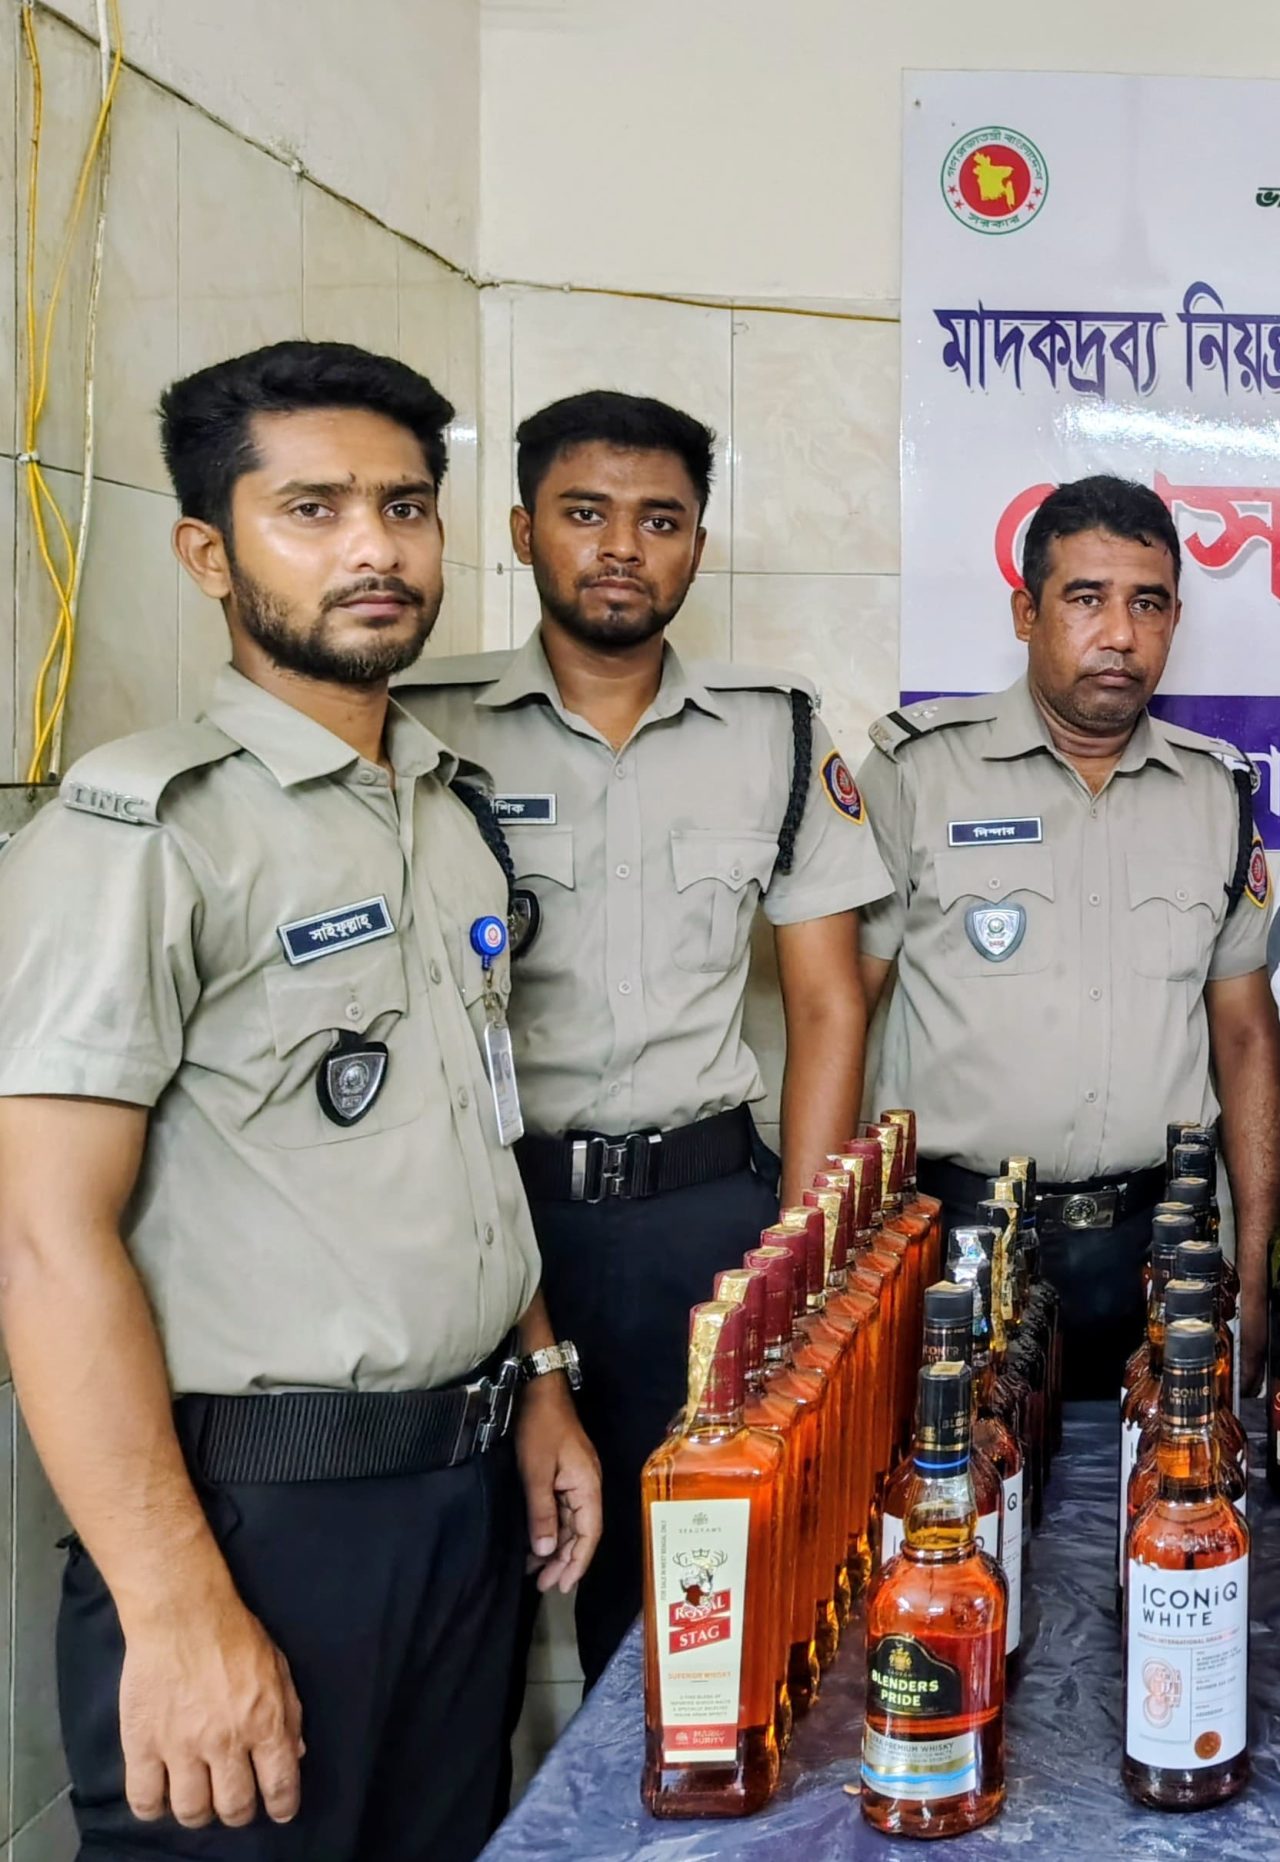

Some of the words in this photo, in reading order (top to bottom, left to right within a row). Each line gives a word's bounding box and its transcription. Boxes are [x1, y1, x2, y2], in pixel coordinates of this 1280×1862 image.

[932, 298, 1167, 402] মাদকদ্রব্য
[1143, 1607, 1213, 1628] WHITE
[679, 1625, 720, 1648] STAG
[871, 1669, 940, 1693] BLENDERS
[881, 1689, 921, 1707] PRIDE
[885, 1739, 918, 1752] PREMIUM
[920, 1741, 954, 1752] WHISKY
